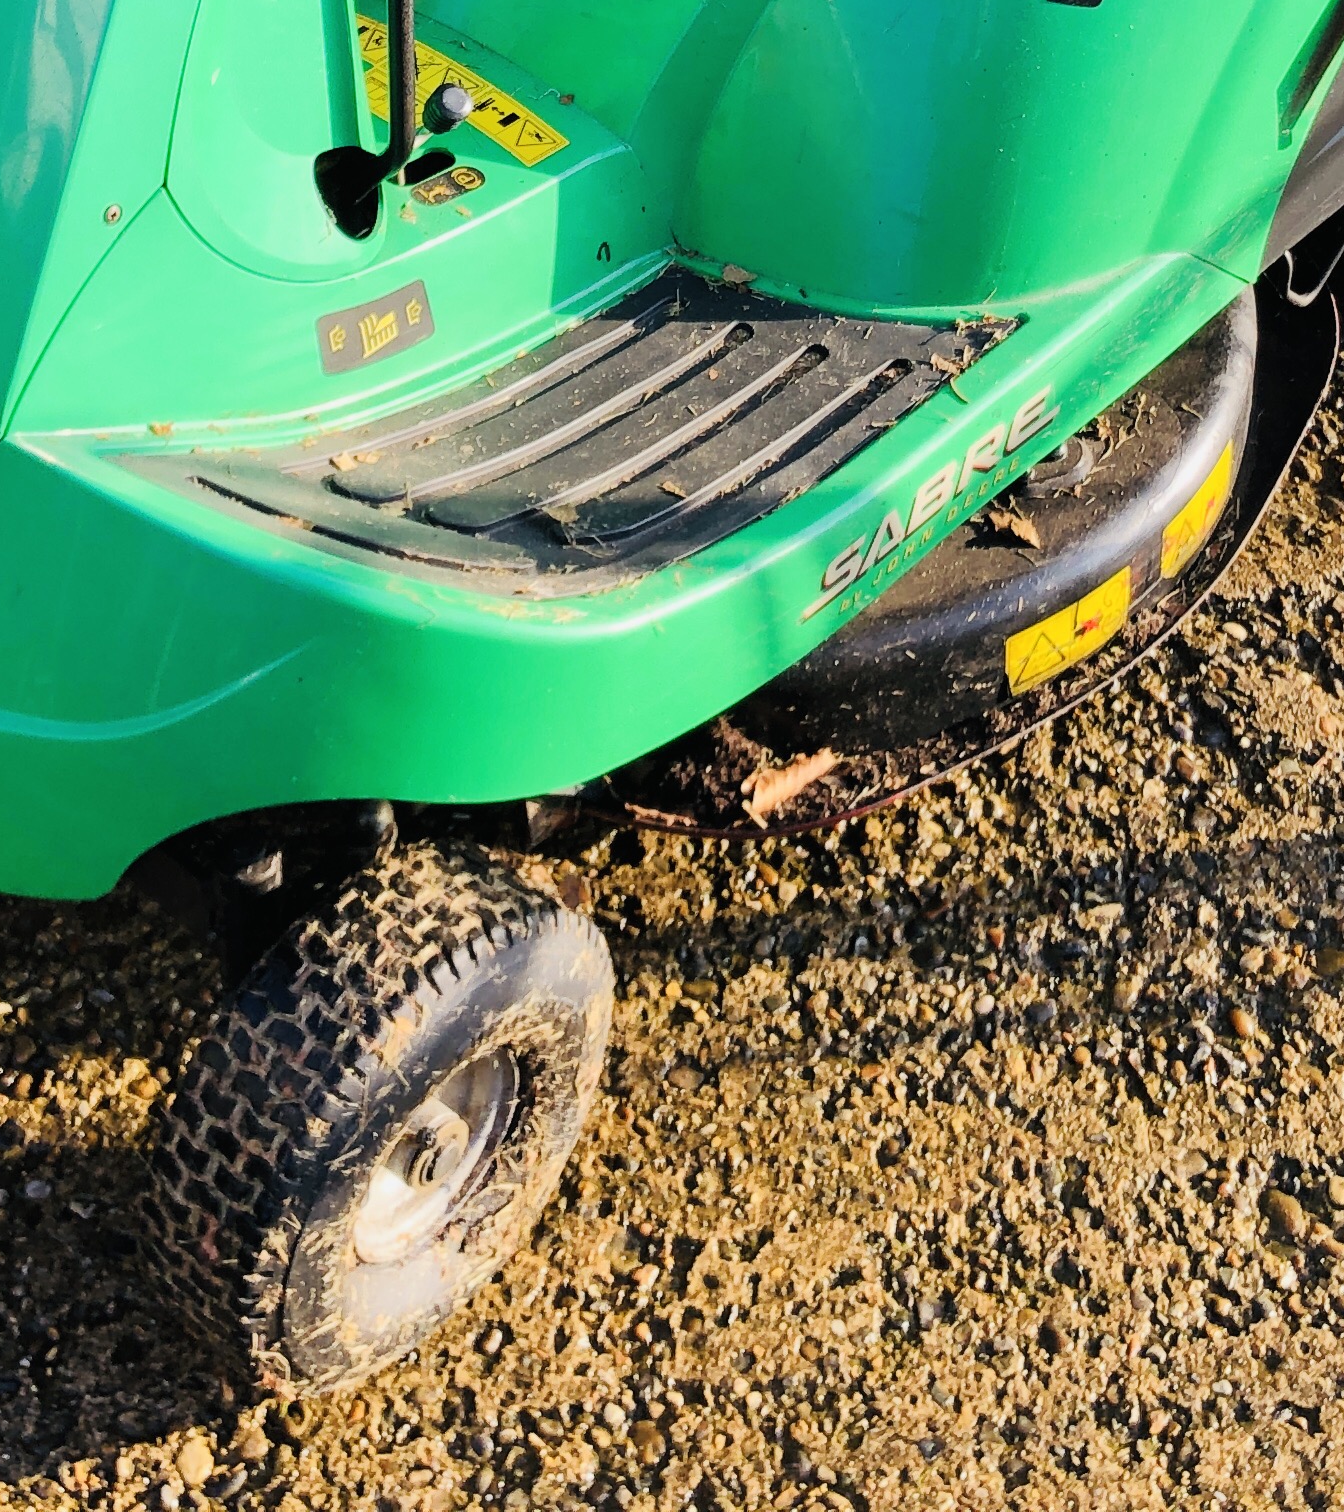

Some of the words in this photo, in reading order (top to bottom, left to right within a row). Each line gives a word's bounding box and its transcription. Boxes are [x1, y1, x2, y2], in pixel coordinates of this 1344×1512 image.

[800, 384, 1061, 623] SABRE
[871, 527, 934, 588] JOHN
[946, 455, 1021, 524] DEERE
